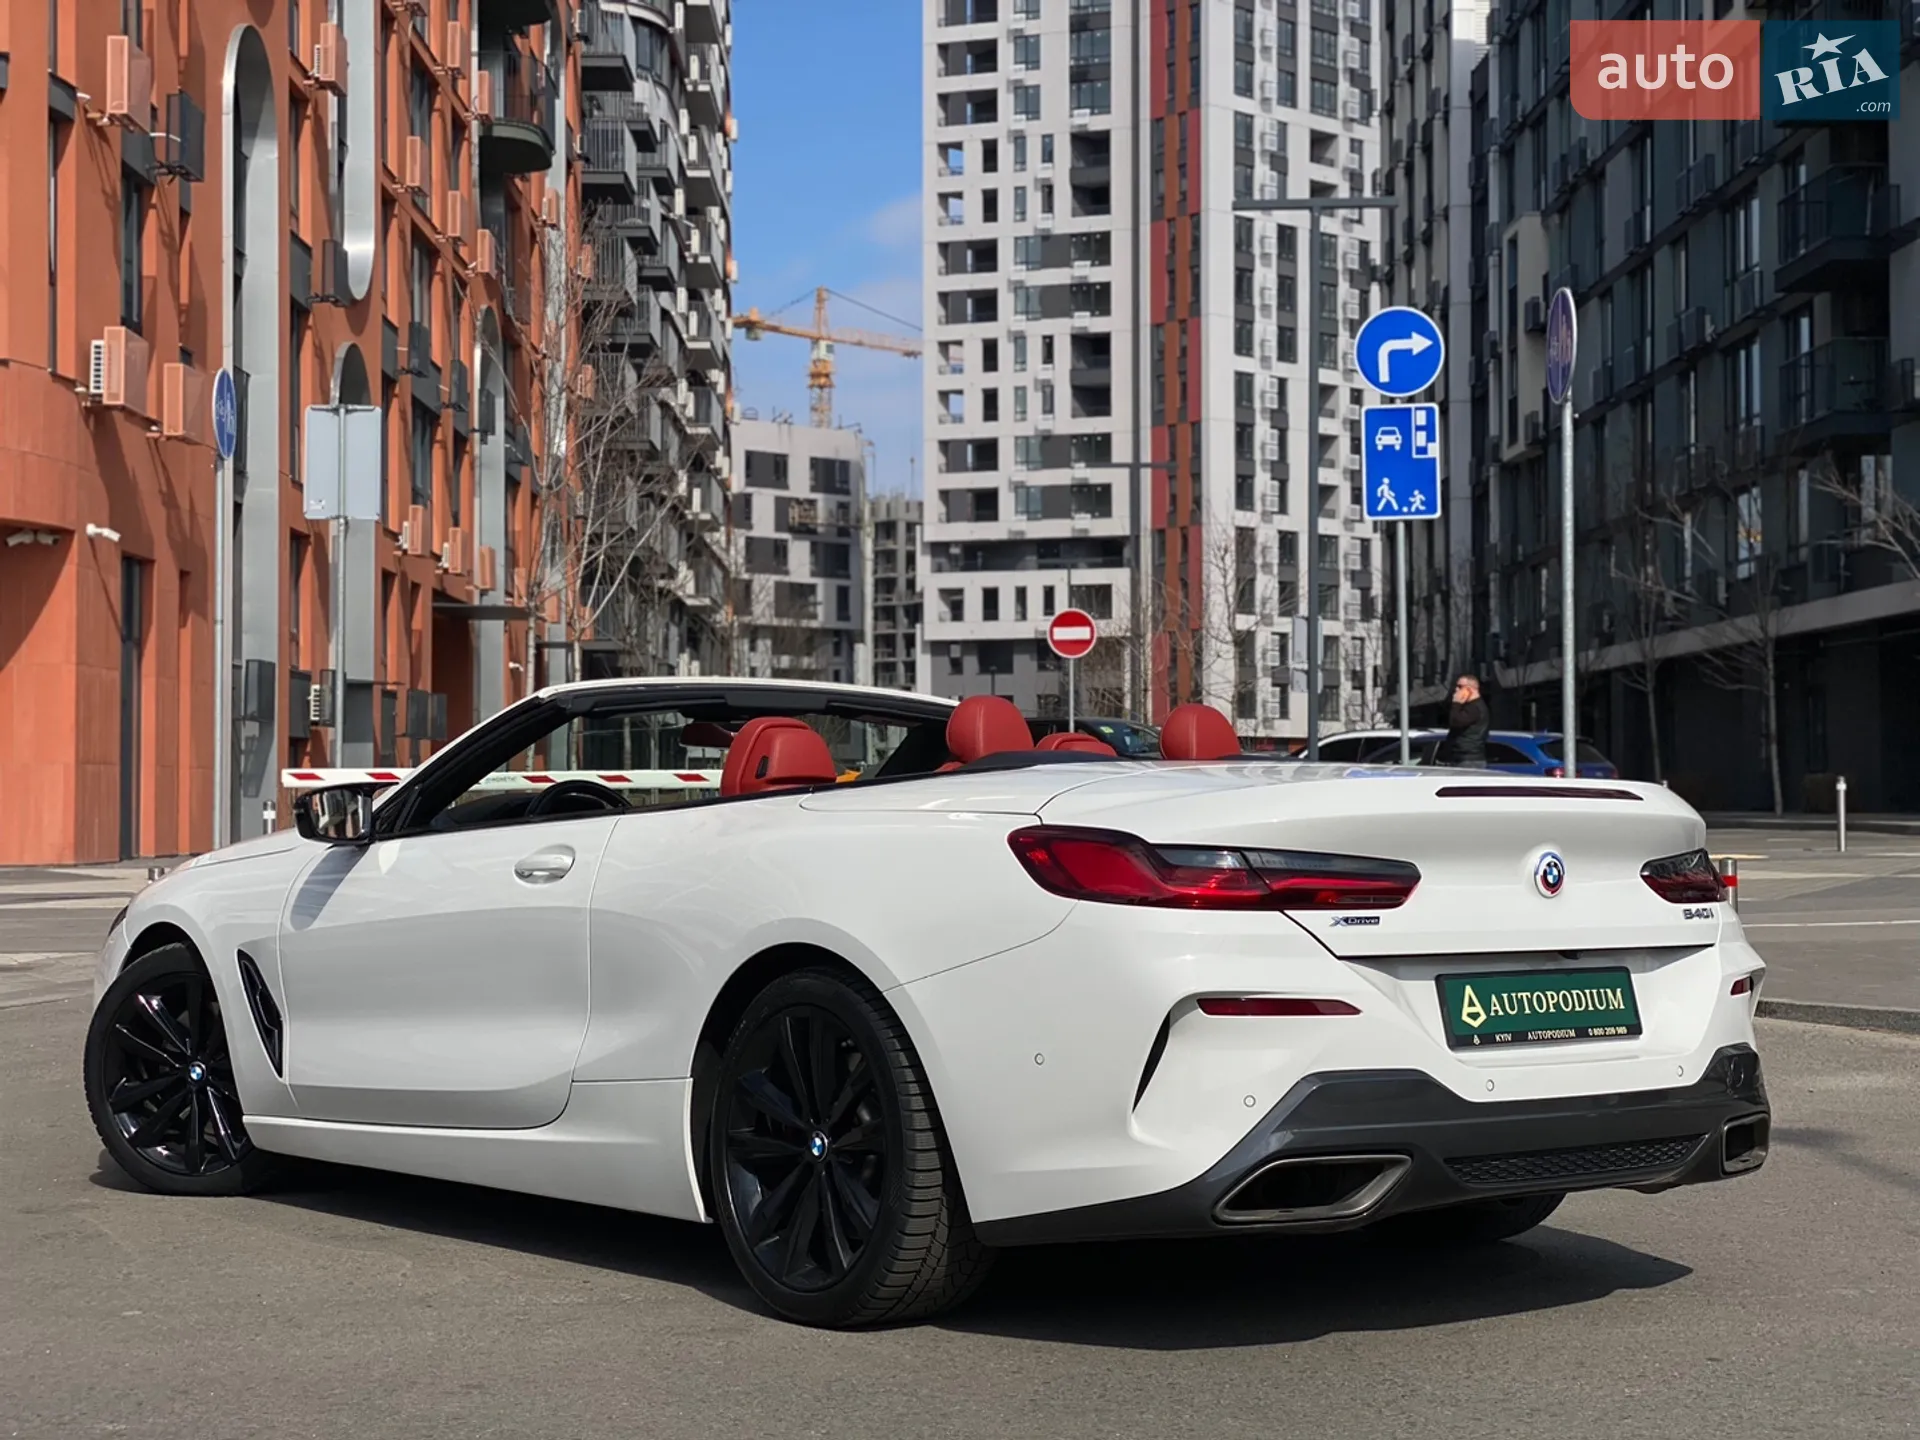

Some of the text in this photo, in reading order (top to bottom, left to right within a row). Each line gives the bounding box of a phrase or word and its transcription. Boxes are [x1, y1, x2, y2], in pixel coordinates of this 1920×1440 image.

[1490, 988, 1625, 1016] AUTOPODIUM
[1495, 1033, 1512, 1042] KYIV
[1528, 1028, 1576, 1041] AUTOPODIUM
